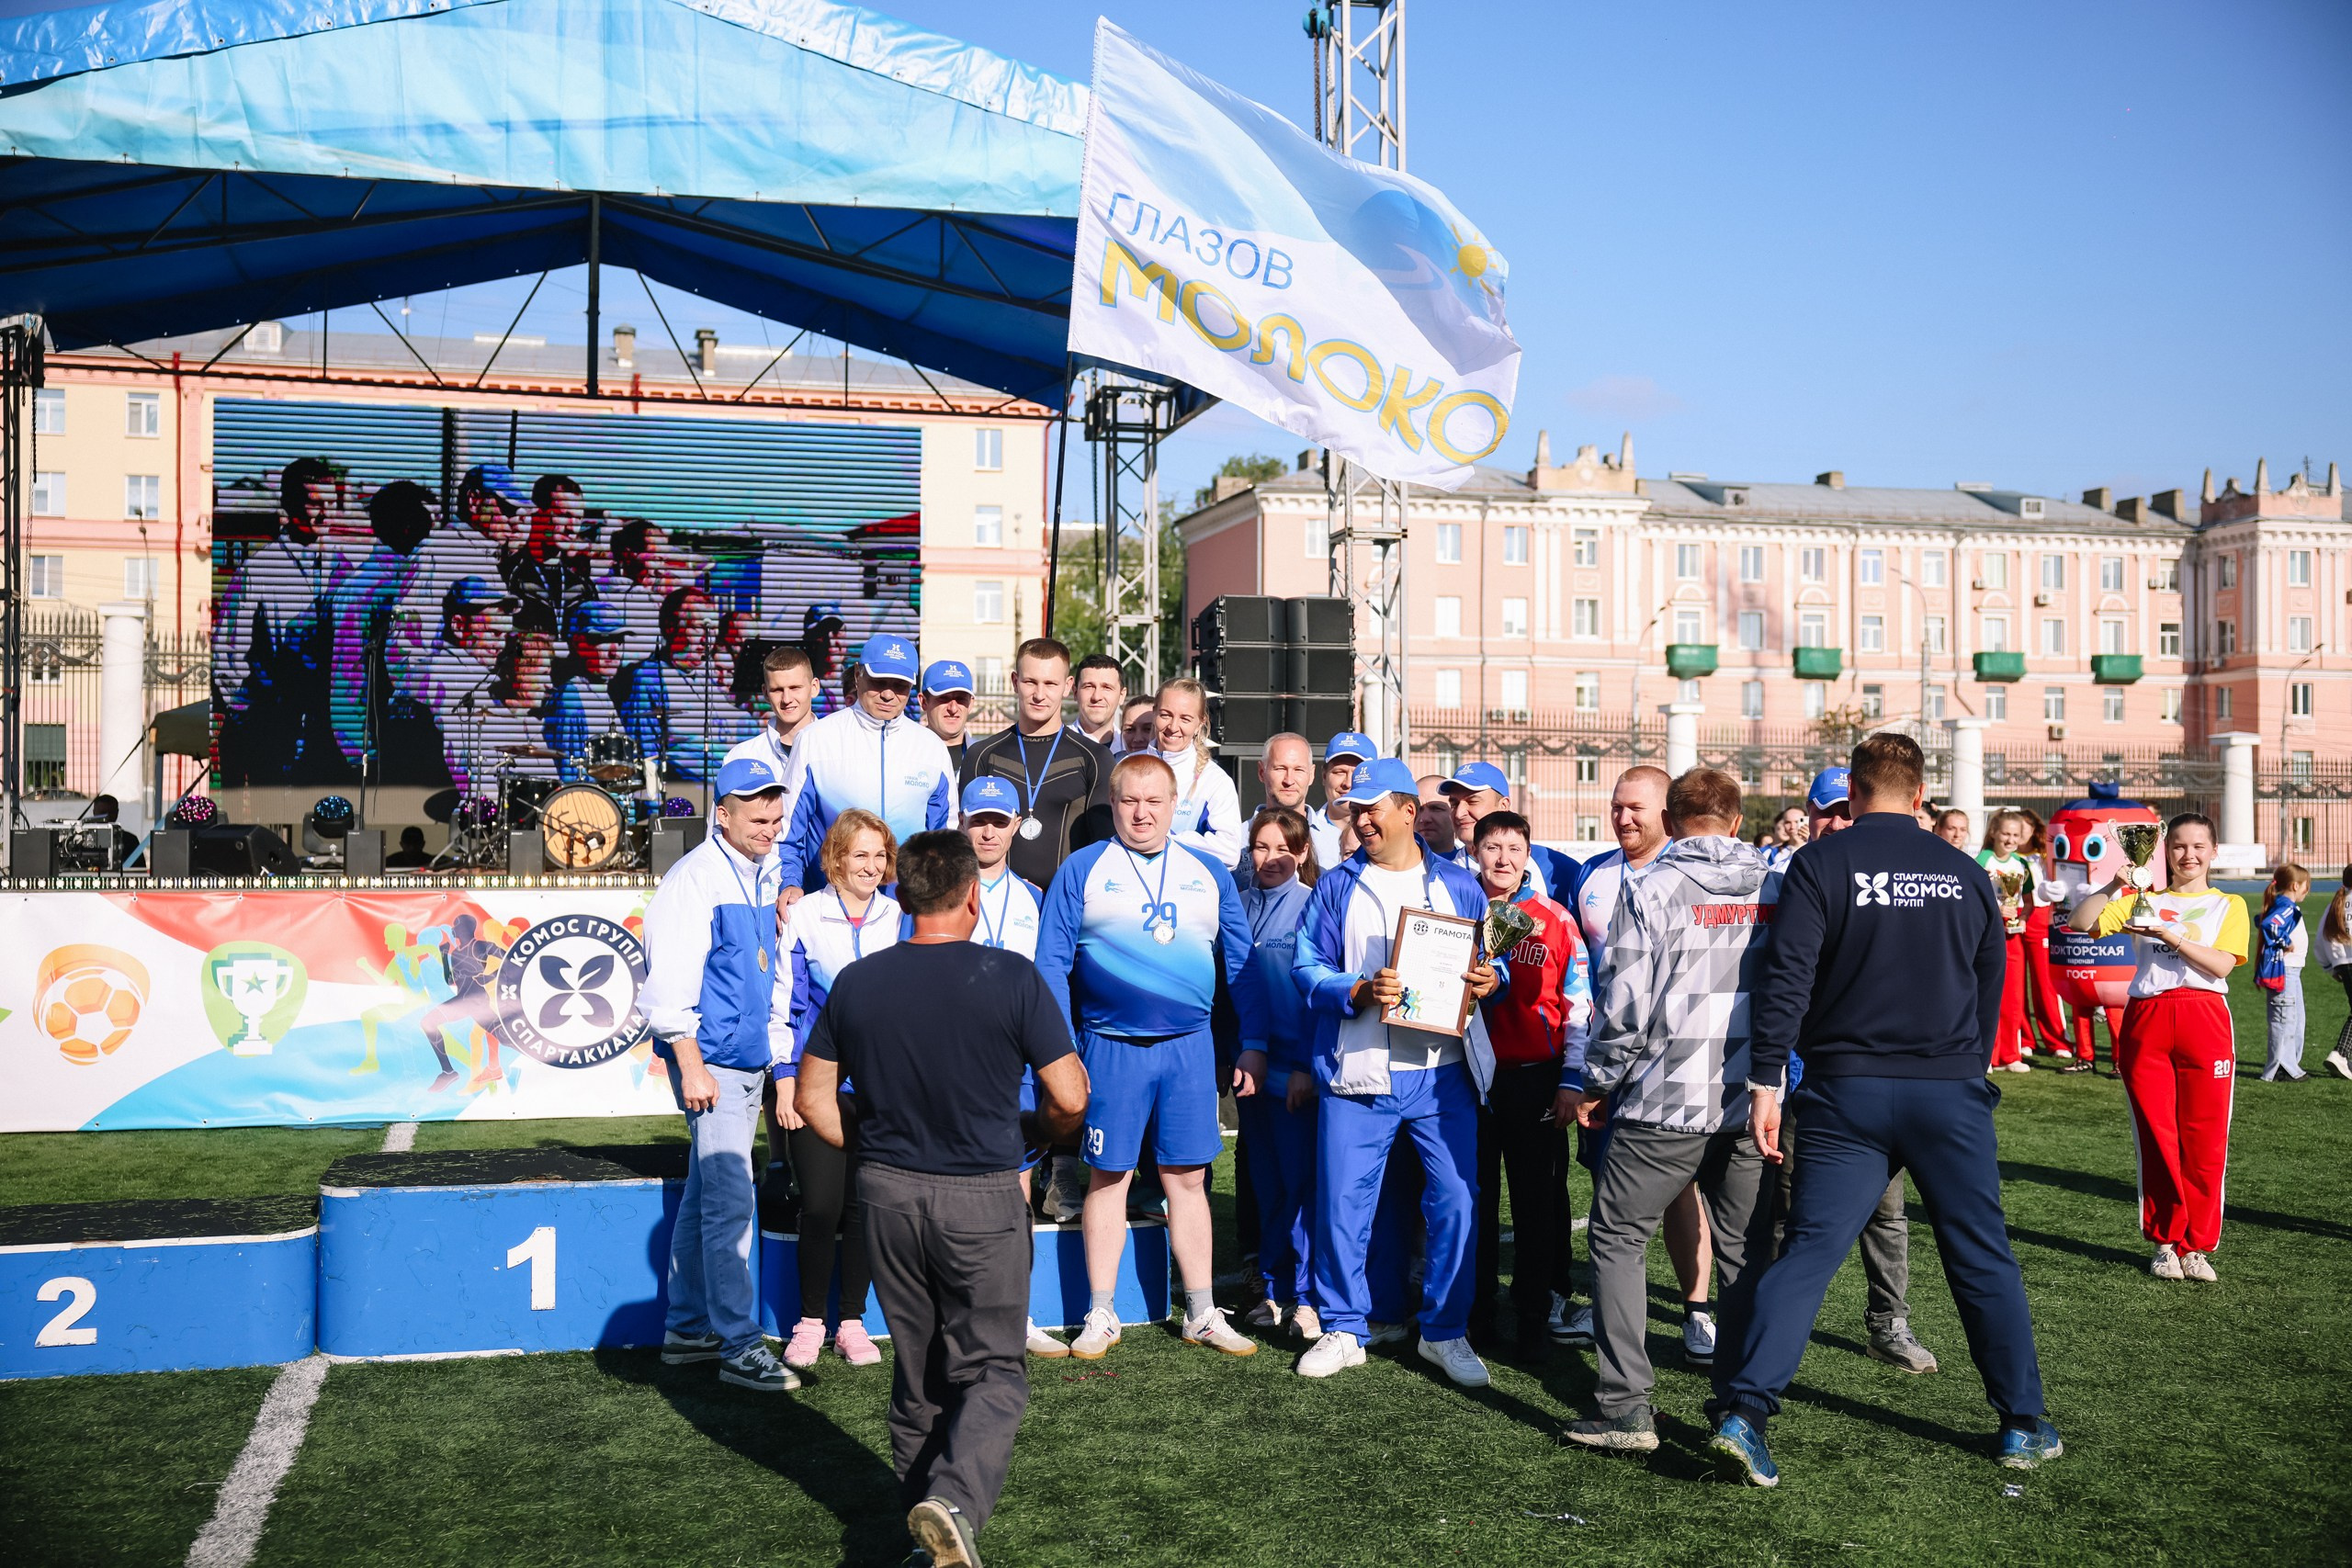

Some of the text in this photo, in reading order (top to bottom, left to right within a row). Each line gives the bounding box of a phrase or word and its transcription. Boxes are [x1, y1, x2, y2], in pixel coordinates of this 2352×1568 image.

[1106, 191, 1294, 290] ГЛАЗОВ
[1099, 236, 1510, 466] МОЛОКО
[904, 780, 930, 789] МОЛОКО
[1893, 873, 1960, 884] СПАРТАКИАДА
[1893, 882, 1963, 900] КОМОС
[1894, 897, 1924, 908] ГРУПП
[1141, 901, 1178, 931] 29
[510, 918, 644, 968] КОМОС ГРУПП
[1433, 927, 1472, 941] ГРАМОТА
[2066, 936, 2095, 944] Колбаса
[2066, 969, 2097, 980] ГОСТ
[511, 1013, 645, 1065] СПАРТАКИАДА
[2213, 1059, 2231, 1075] 20
[1087, 1125, 1104, 1156] 29
[505, 1226, 557, 1311] 1
[35, 1276, 98, 1348] 2
